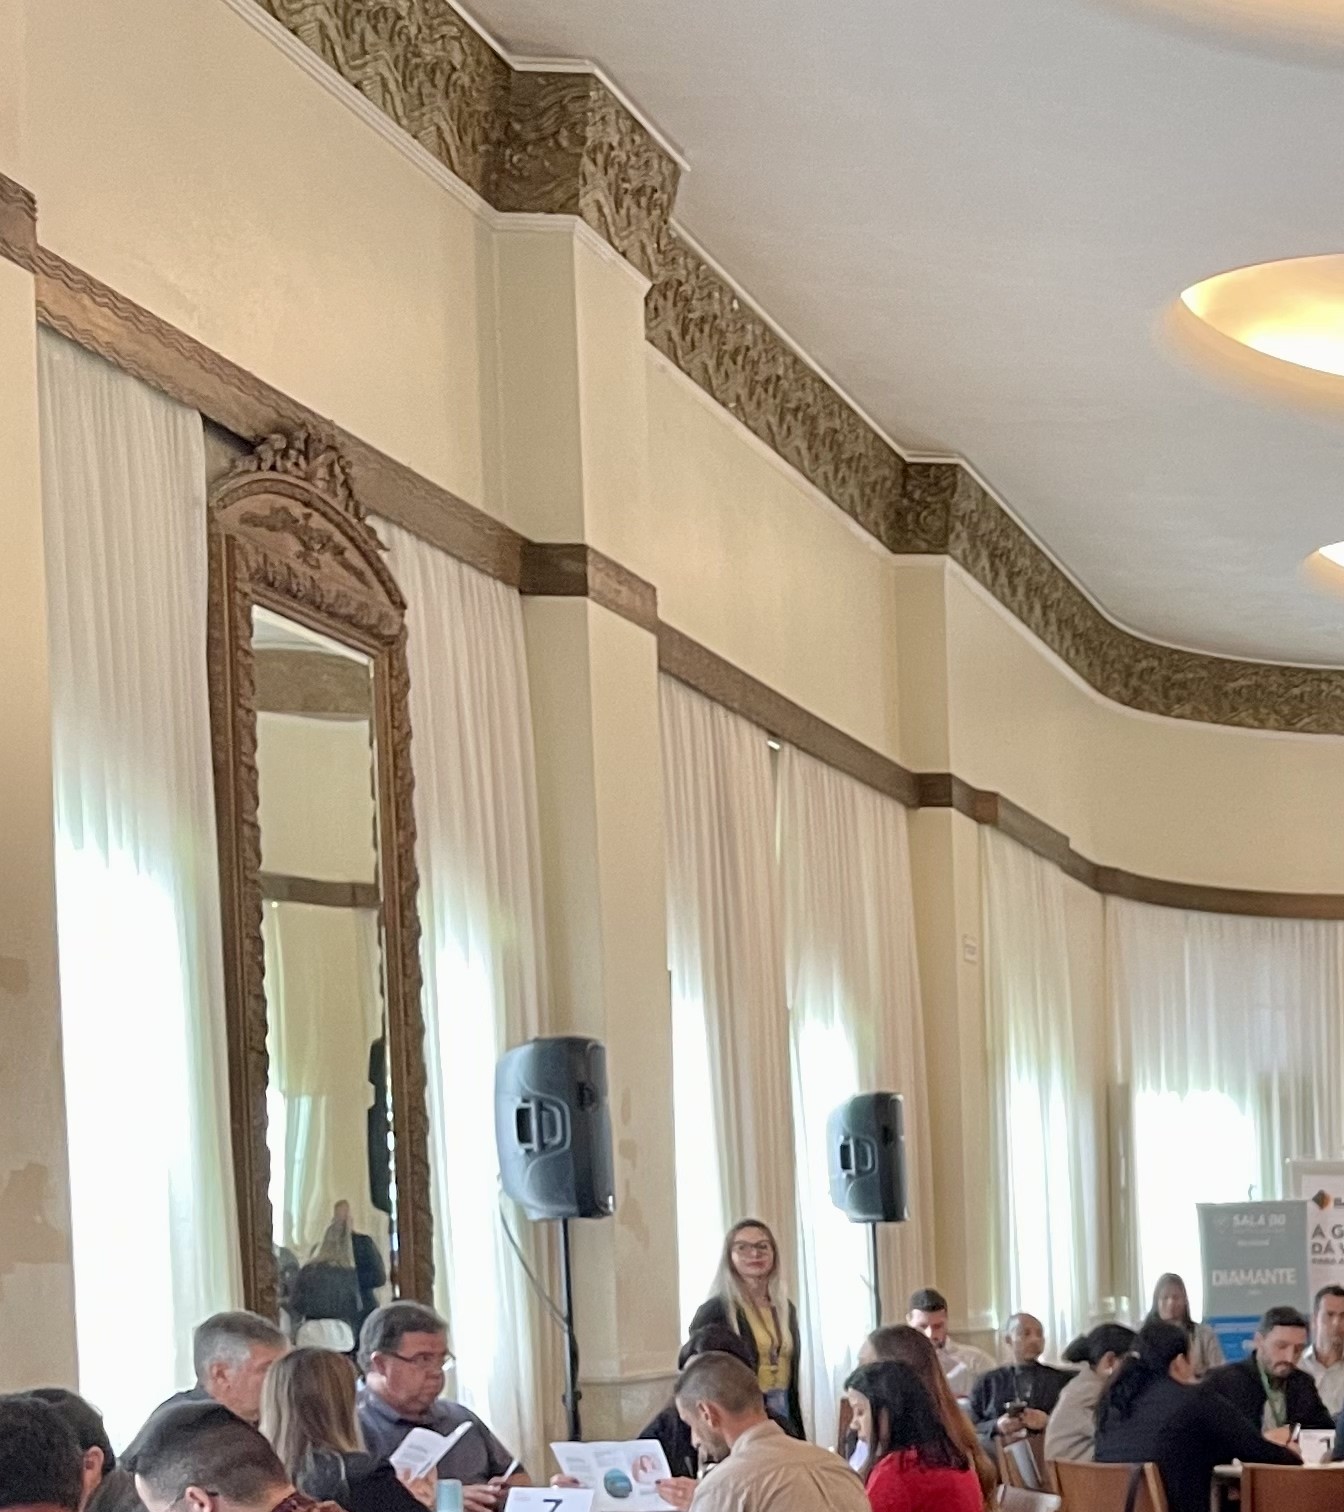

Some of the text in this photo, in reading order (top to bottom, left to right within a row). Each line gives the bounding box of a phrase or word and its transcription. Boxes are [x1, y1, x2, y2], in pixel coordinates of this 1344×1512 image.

[1312, 1224, 1326, 1239] A
[1311, 1240, 1335, 1256] DÁ
[1212, 1267, 1297, 1287] DIAMANTE
